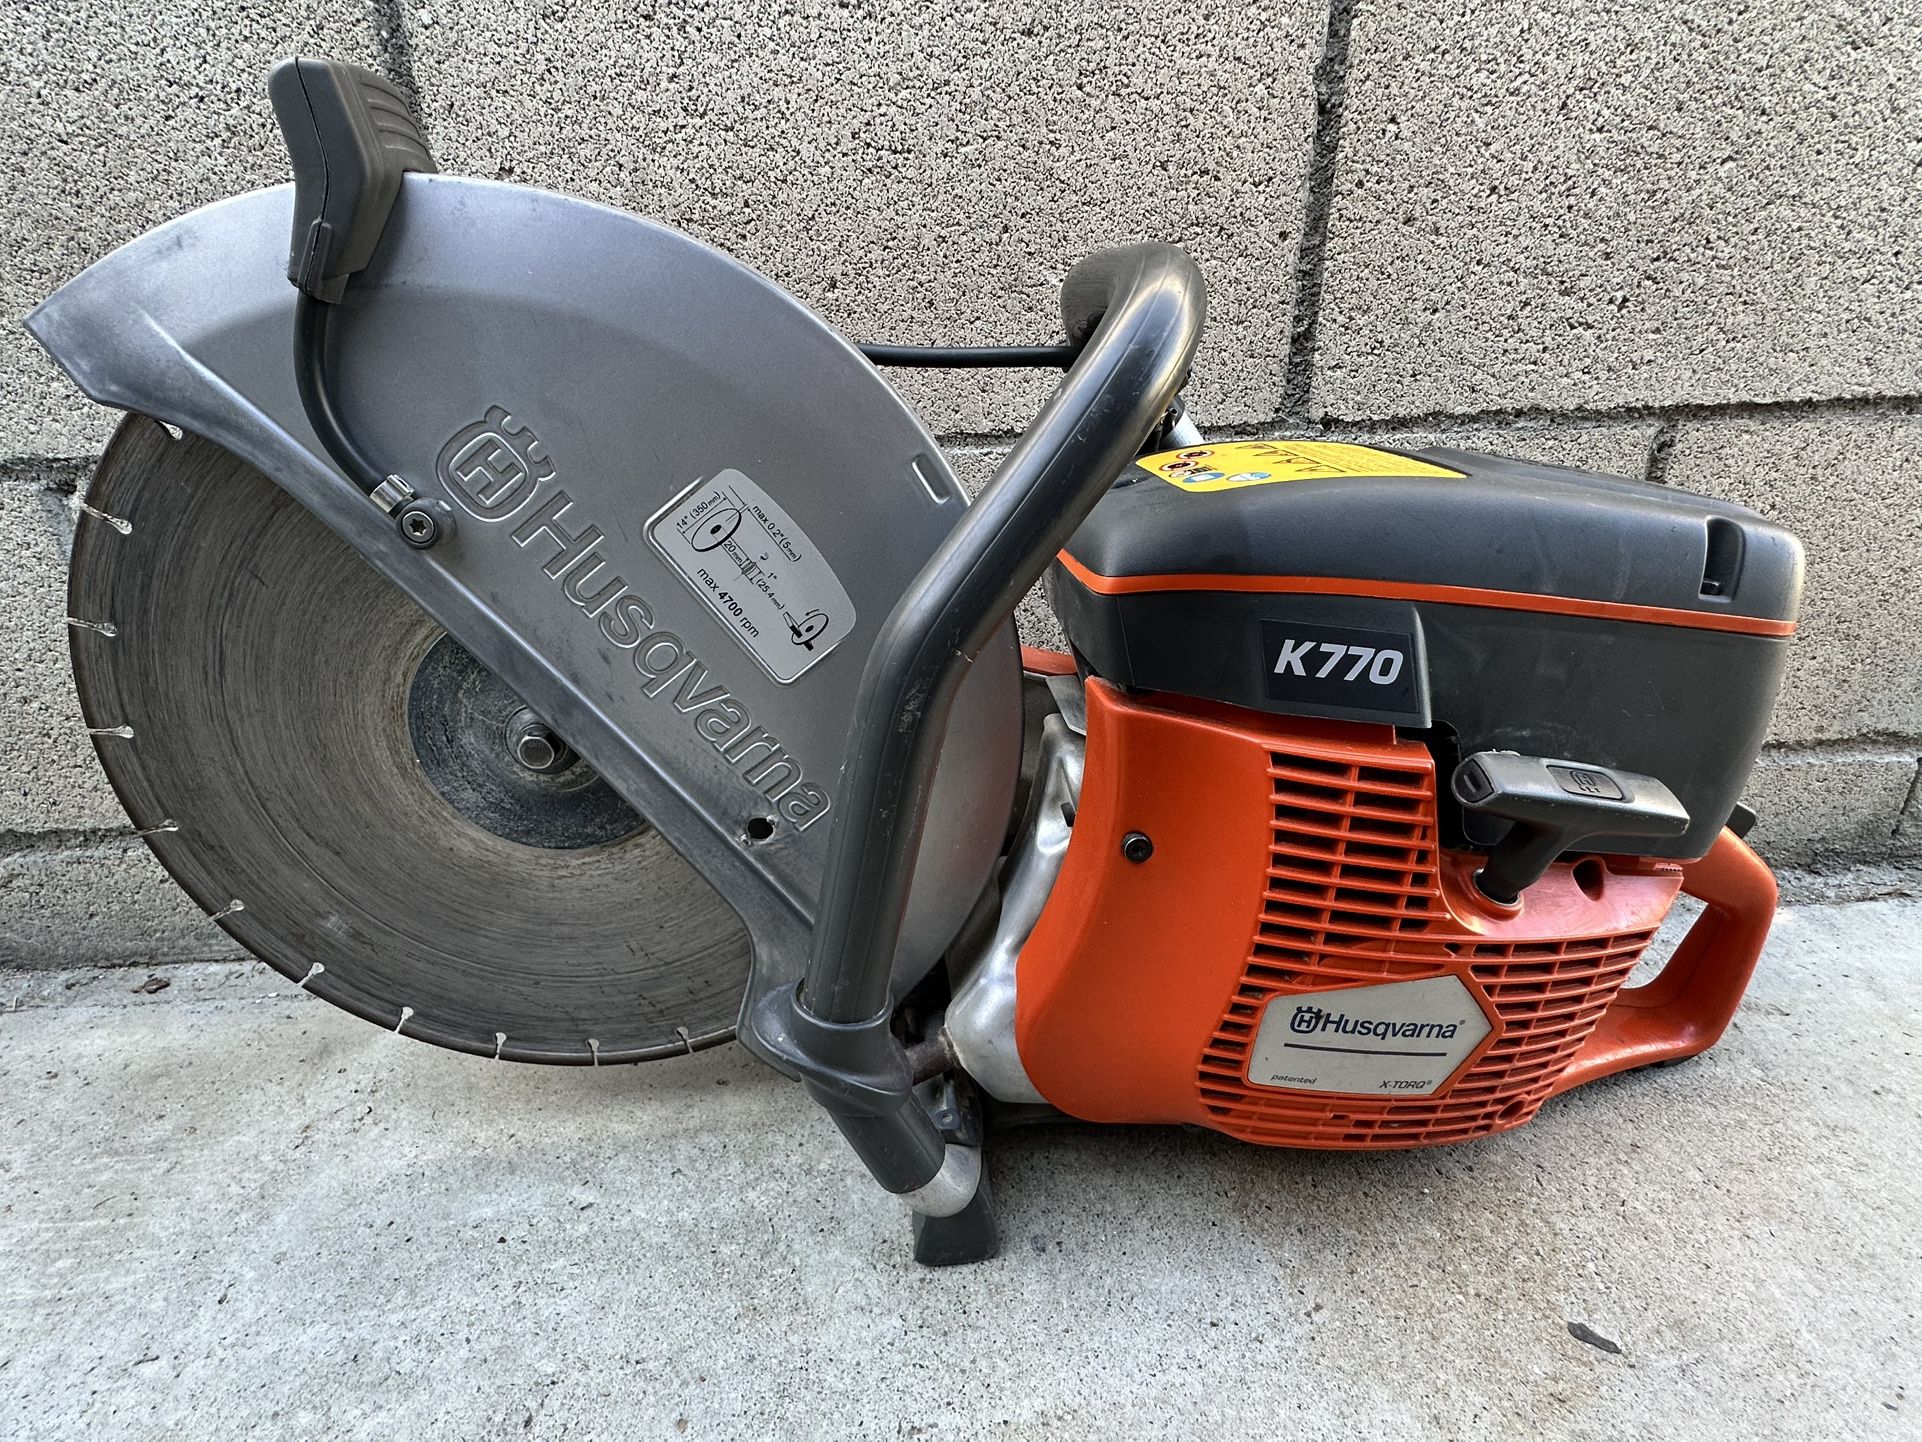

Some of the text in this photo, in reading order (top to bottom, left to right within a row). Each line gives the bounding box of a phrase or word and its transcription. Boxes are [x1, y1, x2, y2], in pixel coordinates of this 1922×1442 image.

[676, 491, 721, 529] 14" (350mm)
[752, 505, 769, 524] max
[697, 568, 760, 638] max 4700 rpm
[510, 490, 830, 831] Husqvarna
[1271, 1074, 1317, 1084] patented
